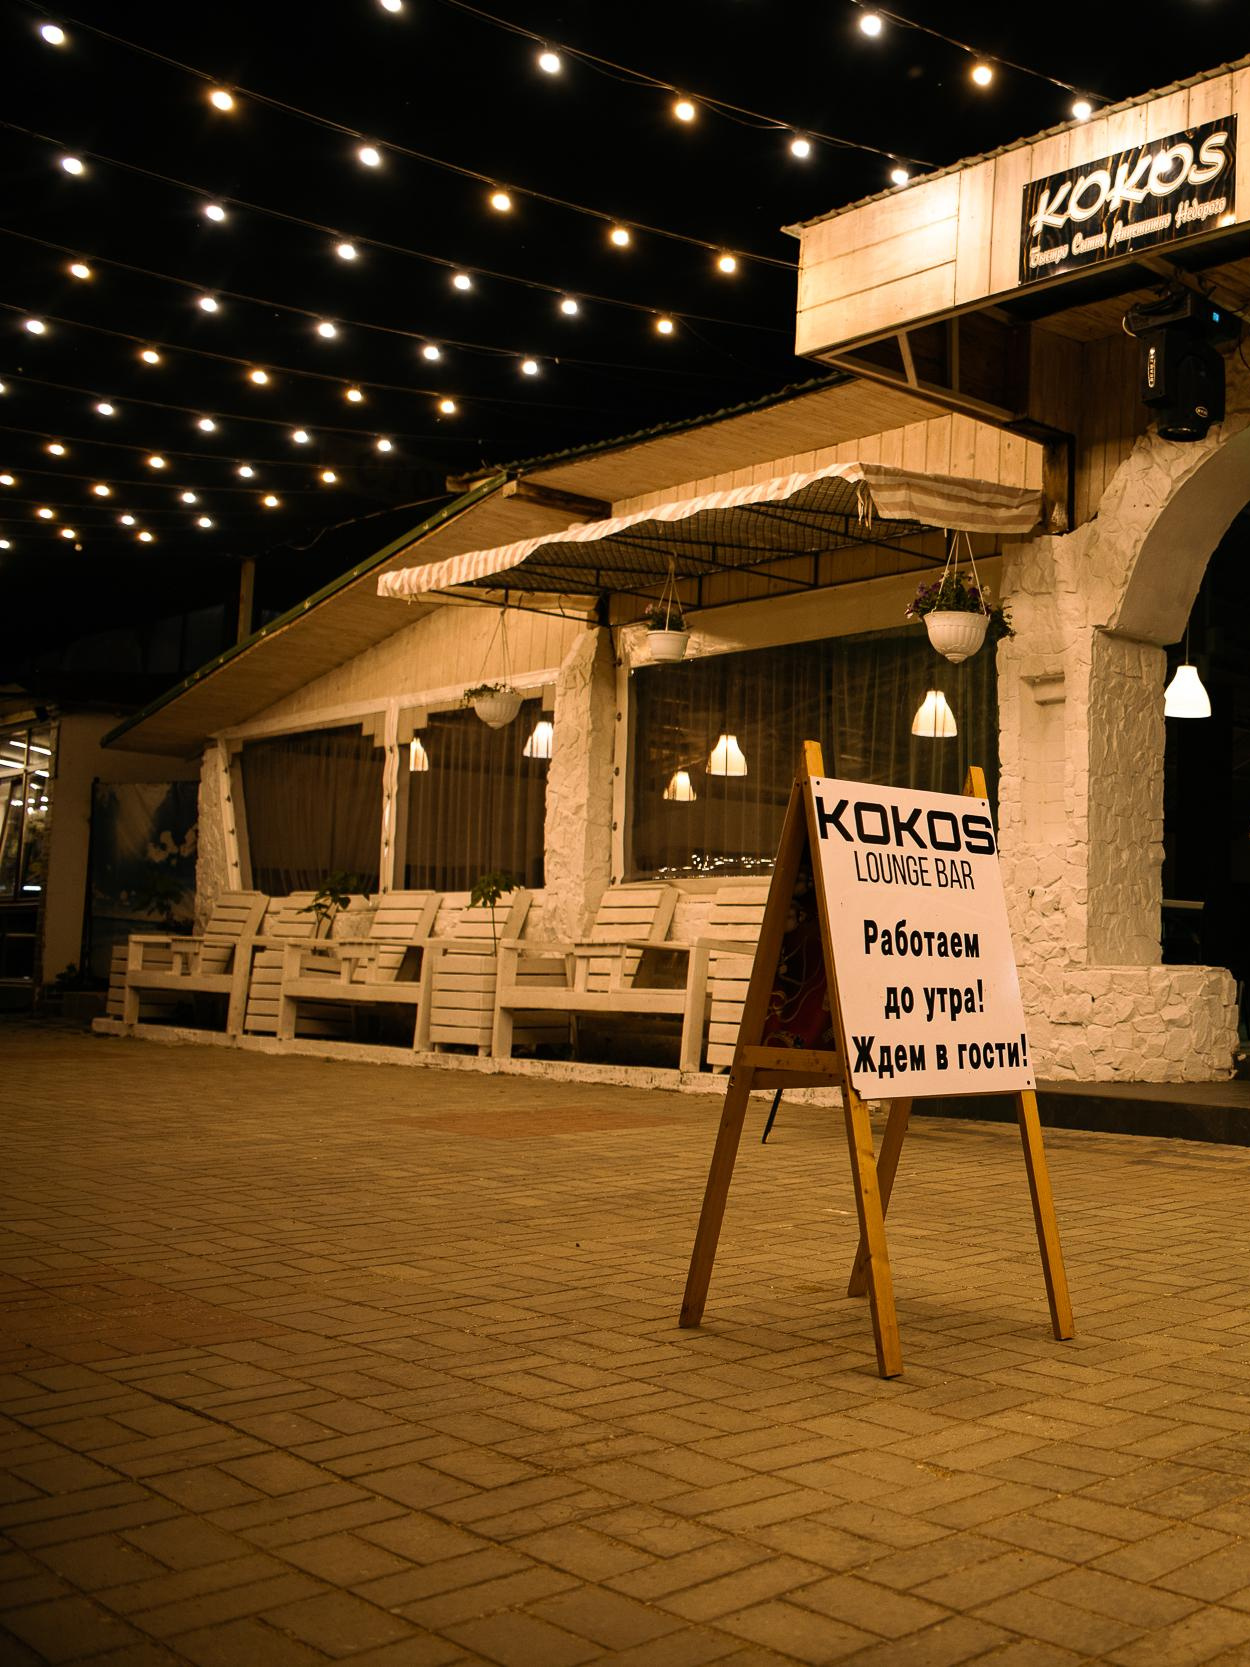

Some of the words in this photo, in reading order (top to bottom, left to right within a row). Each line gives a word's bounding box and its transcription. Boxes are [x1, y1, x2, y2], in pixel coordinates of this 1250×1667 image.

[1030, 131, 1228, 237] KOKOS
[1072, 232, 1107, 255] Сытно
[1175, 197, 1227, 229] Недорого
[815, 796, 995, 855] KOKOS
[854, 850, 932, 887] LOUNGE
[935, 857, 975, 890] BAR
[864, 919, 980, 958] Работаем
[884, 986, 914, 1019] до
[923, 979, 984, 1022] утра!
[852, 1036, 926, 1079] Ждем
[936, 1044, 948, 1070] в
[958, 1033, 1028, 1070] гости!
